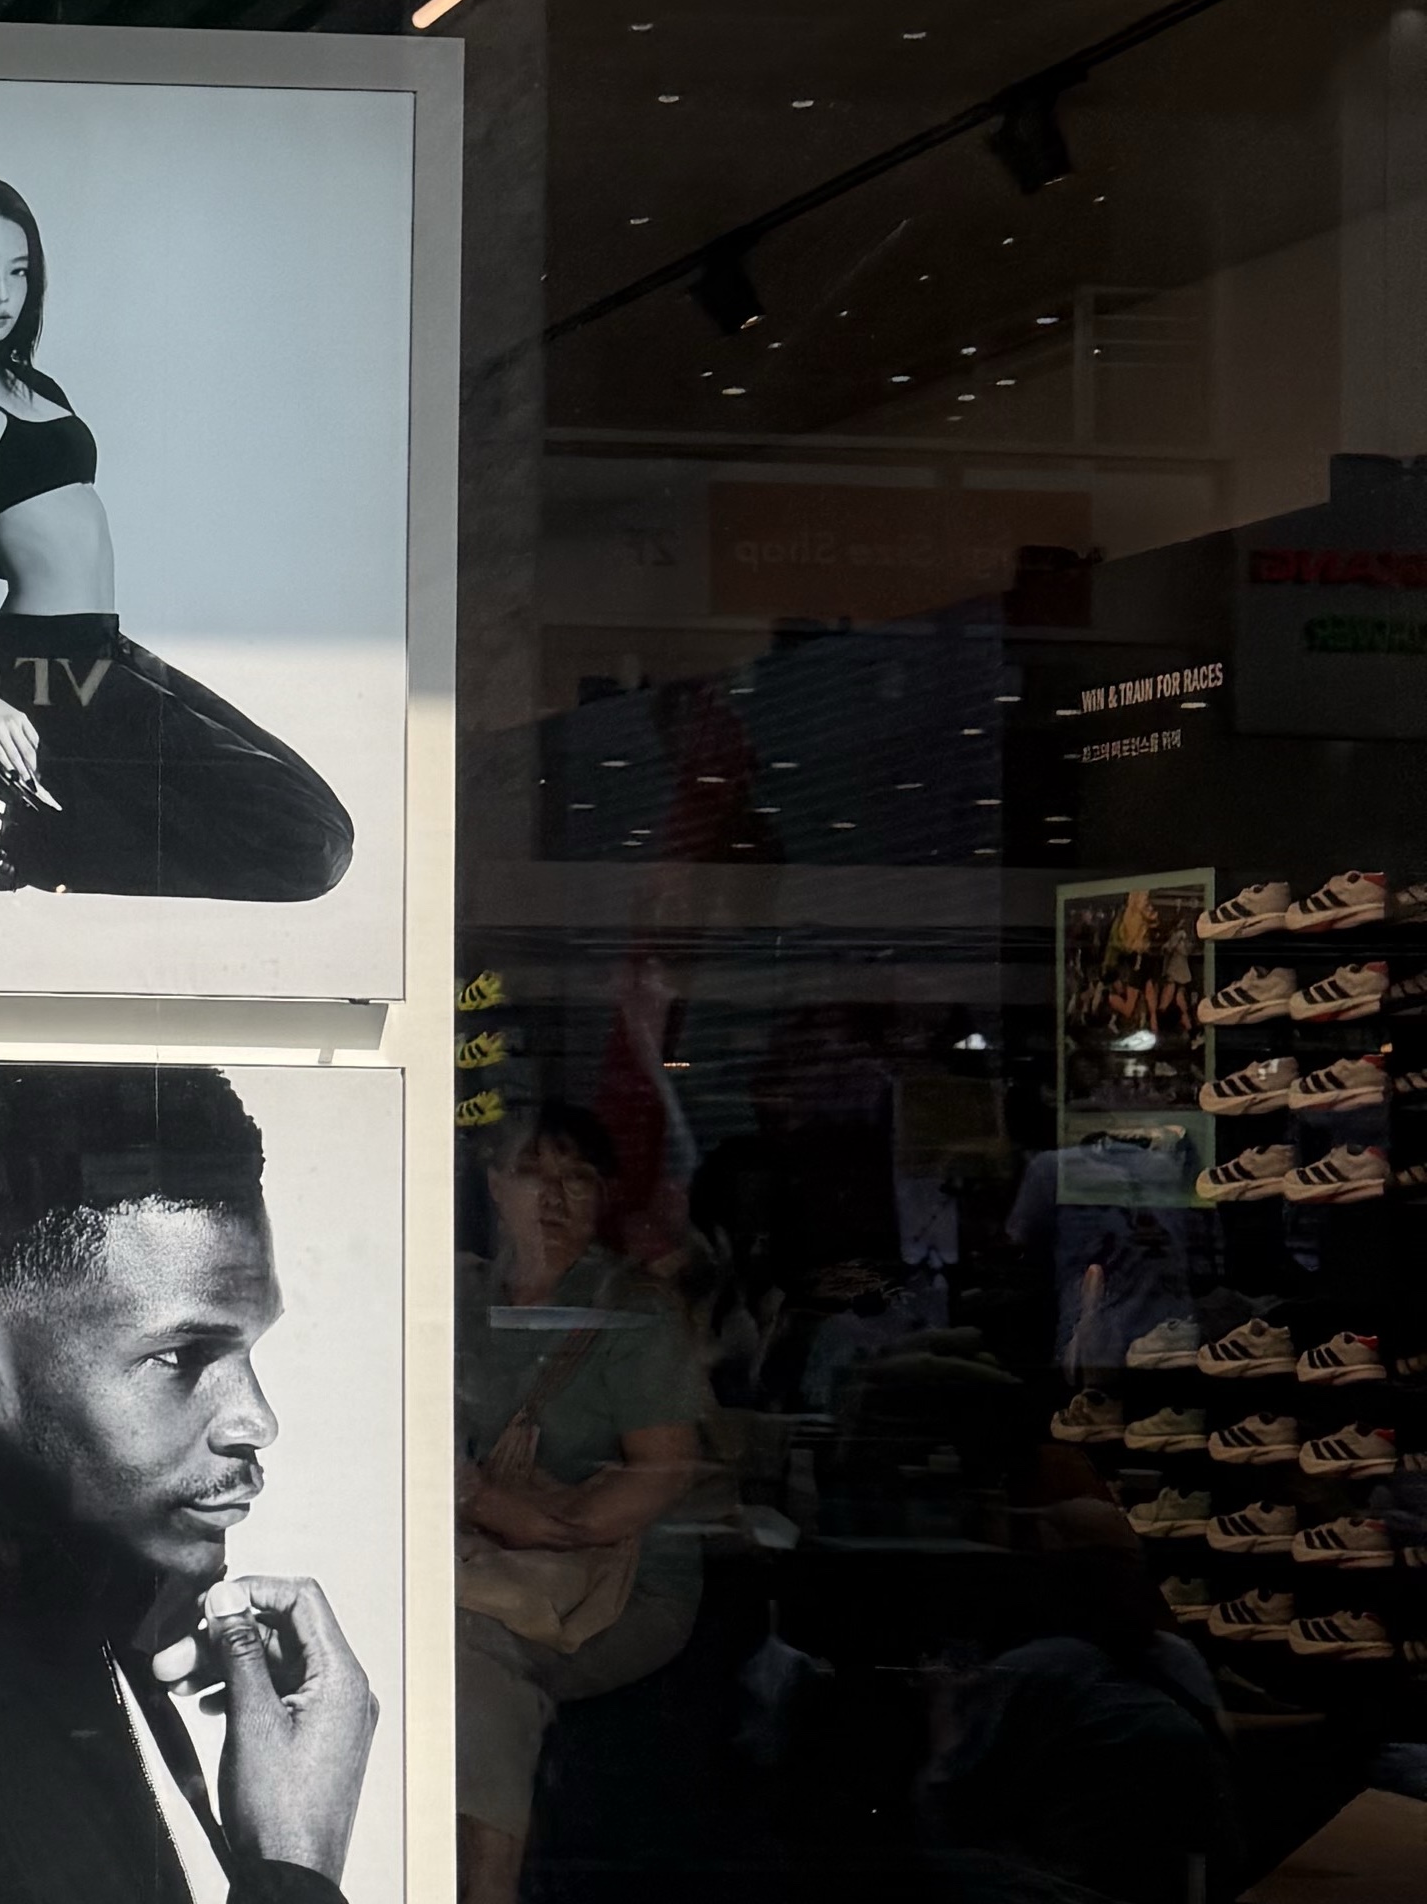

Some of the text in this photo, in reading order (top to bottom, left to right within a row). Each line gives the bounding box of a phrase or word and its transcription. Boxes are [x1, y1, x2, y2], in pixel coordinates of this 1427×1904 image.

[1081, 661, 1224, 713] WIN & TRAIN FOR RACES
